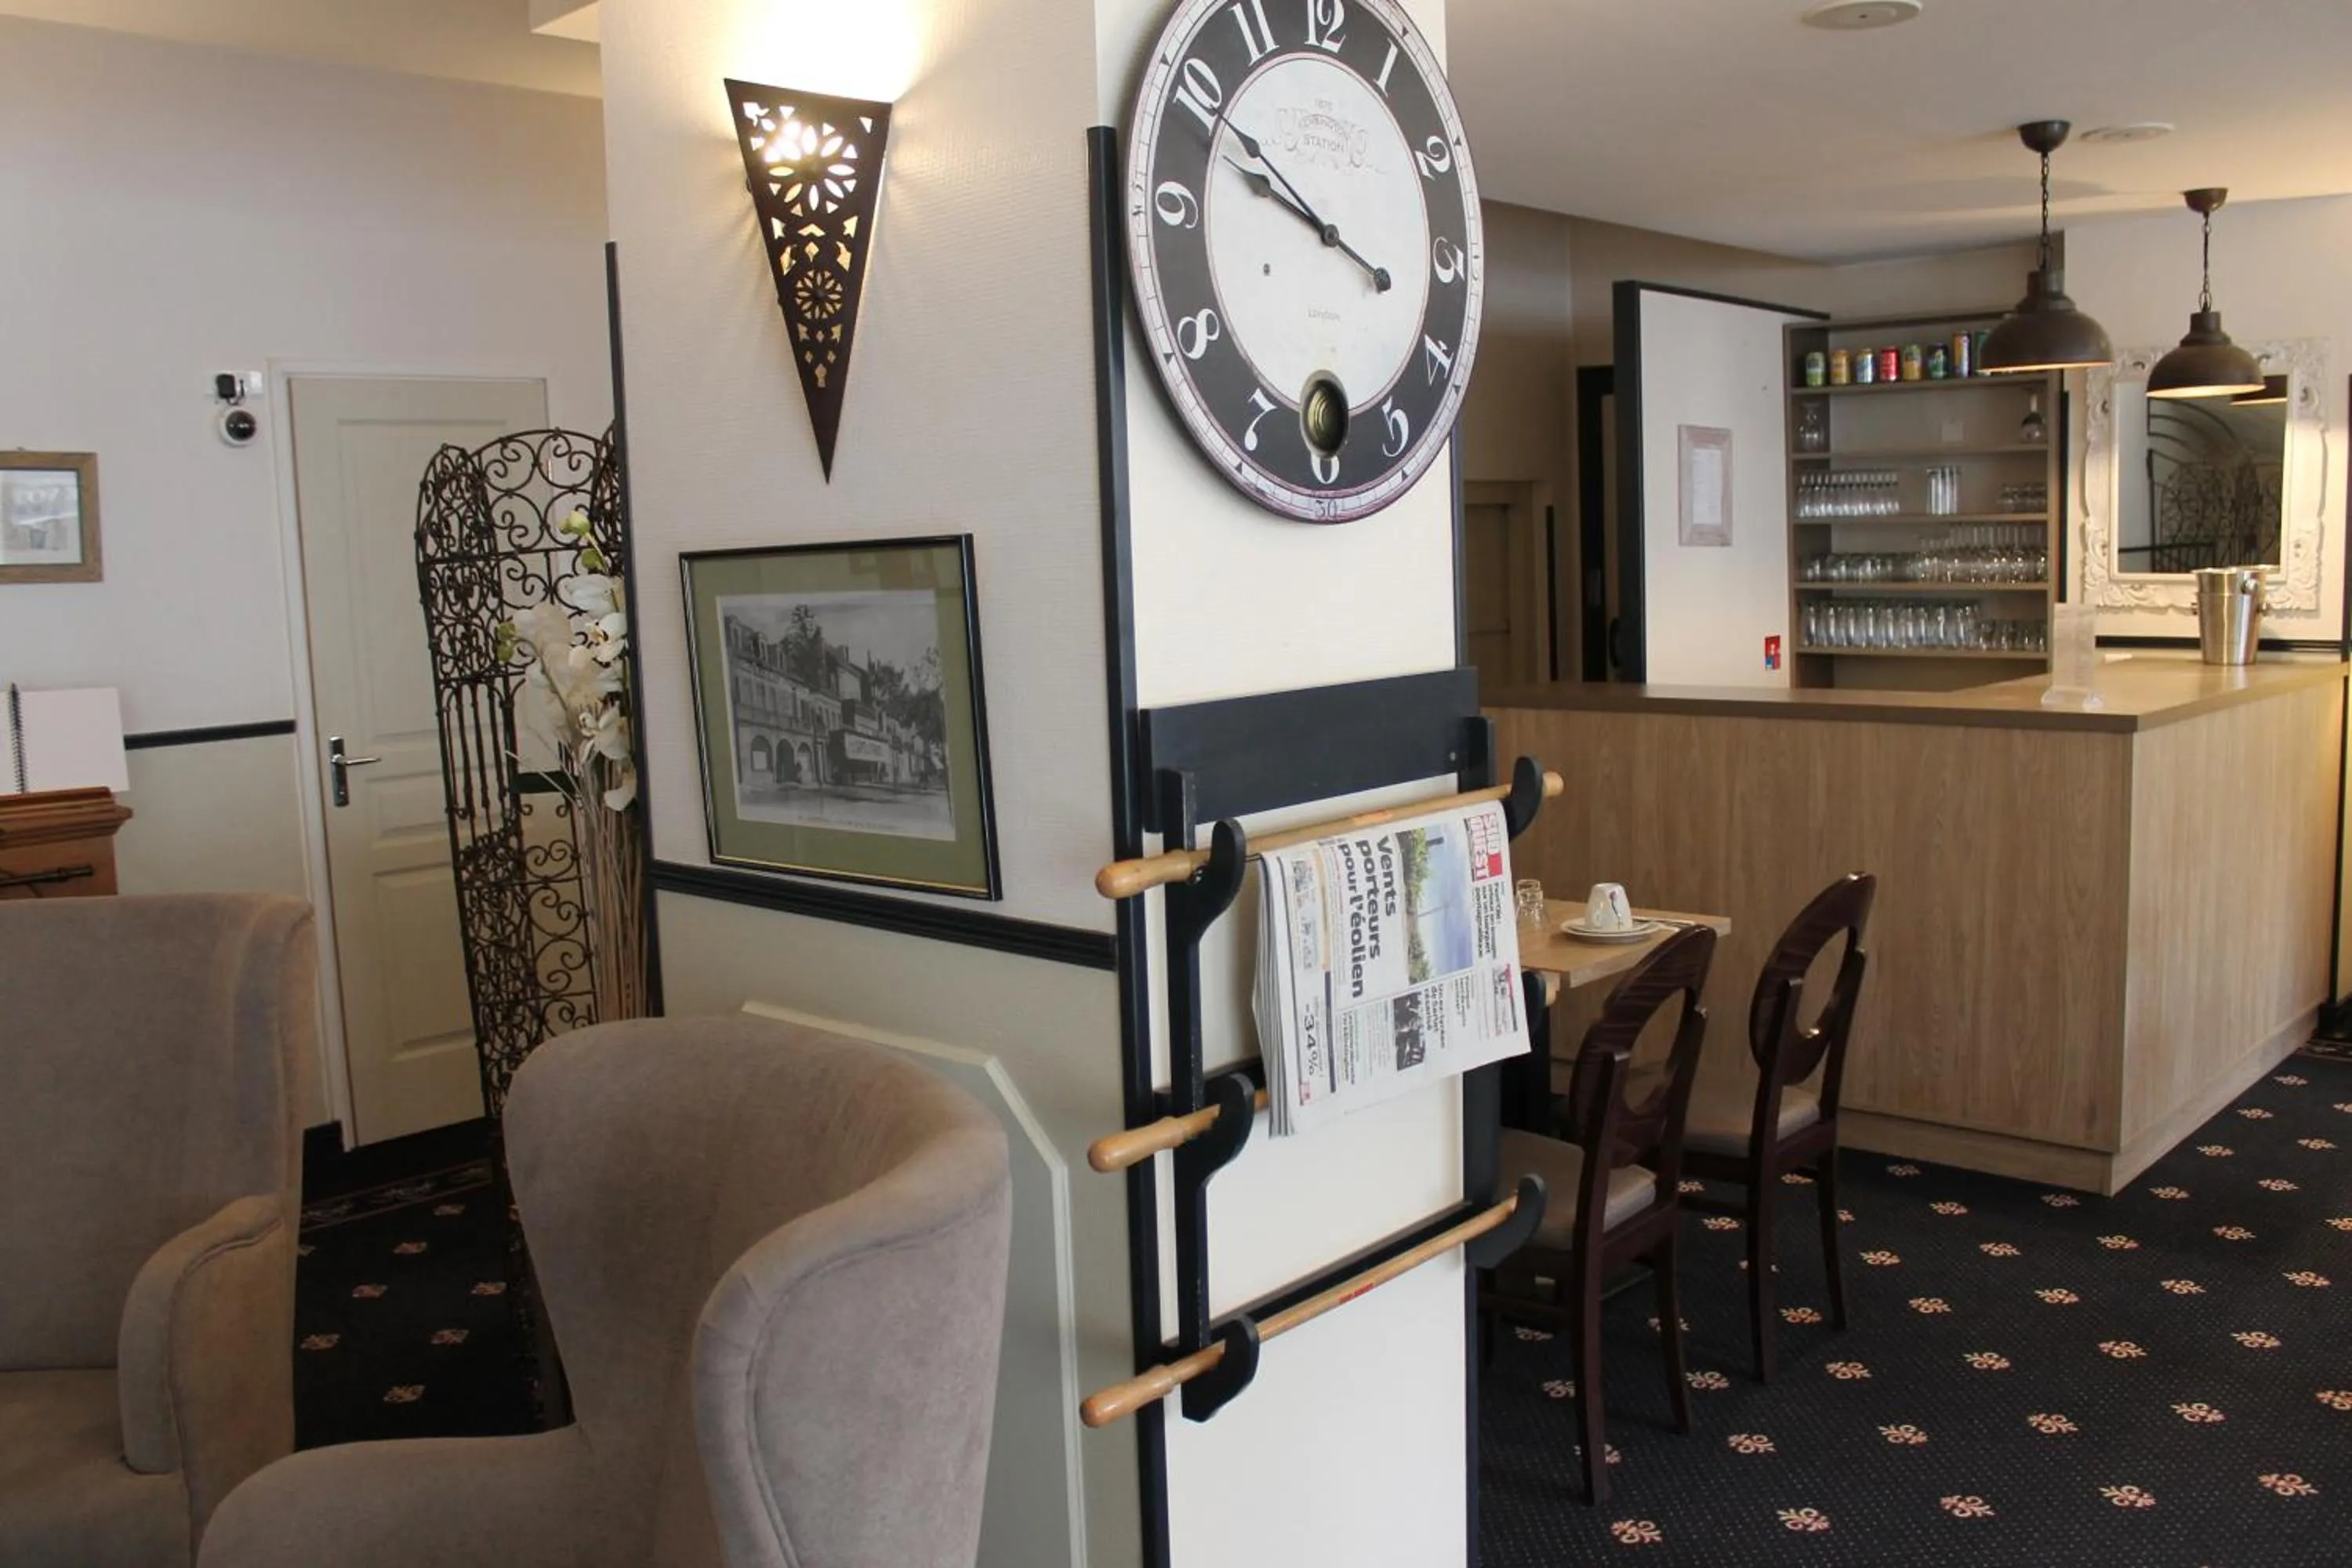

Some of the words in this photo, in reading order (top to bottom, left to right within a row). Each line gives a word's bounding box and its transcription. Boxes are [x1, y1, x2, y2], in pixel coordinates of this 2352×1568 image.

[1228, 0, 1279, 67] 11
[1305, 0, 1346, 53] 12
[1173, 58, 1222, 136] 10
[1373, 38, 1398, 97] 1
[1303, 133, 1345, 153] STATION
[1414, 136, 1450, 181] 2
[1155, 181, 1198, 229] 9
[1432, 237, 1465, 284] 3
[1178, 308, 1220, 360] 8
[1425, 333, 1455, 387] 4
[1243, 388, 1278, 452] 7
[1381, 395, 1410, 458] 5
[1355, 840, 1380, 960] porteurs
[1377, 835, 1396, 916] Vents
[1338, 843, 1357, 893] pour
[1349, 895, 1366, 998] l'éolien
